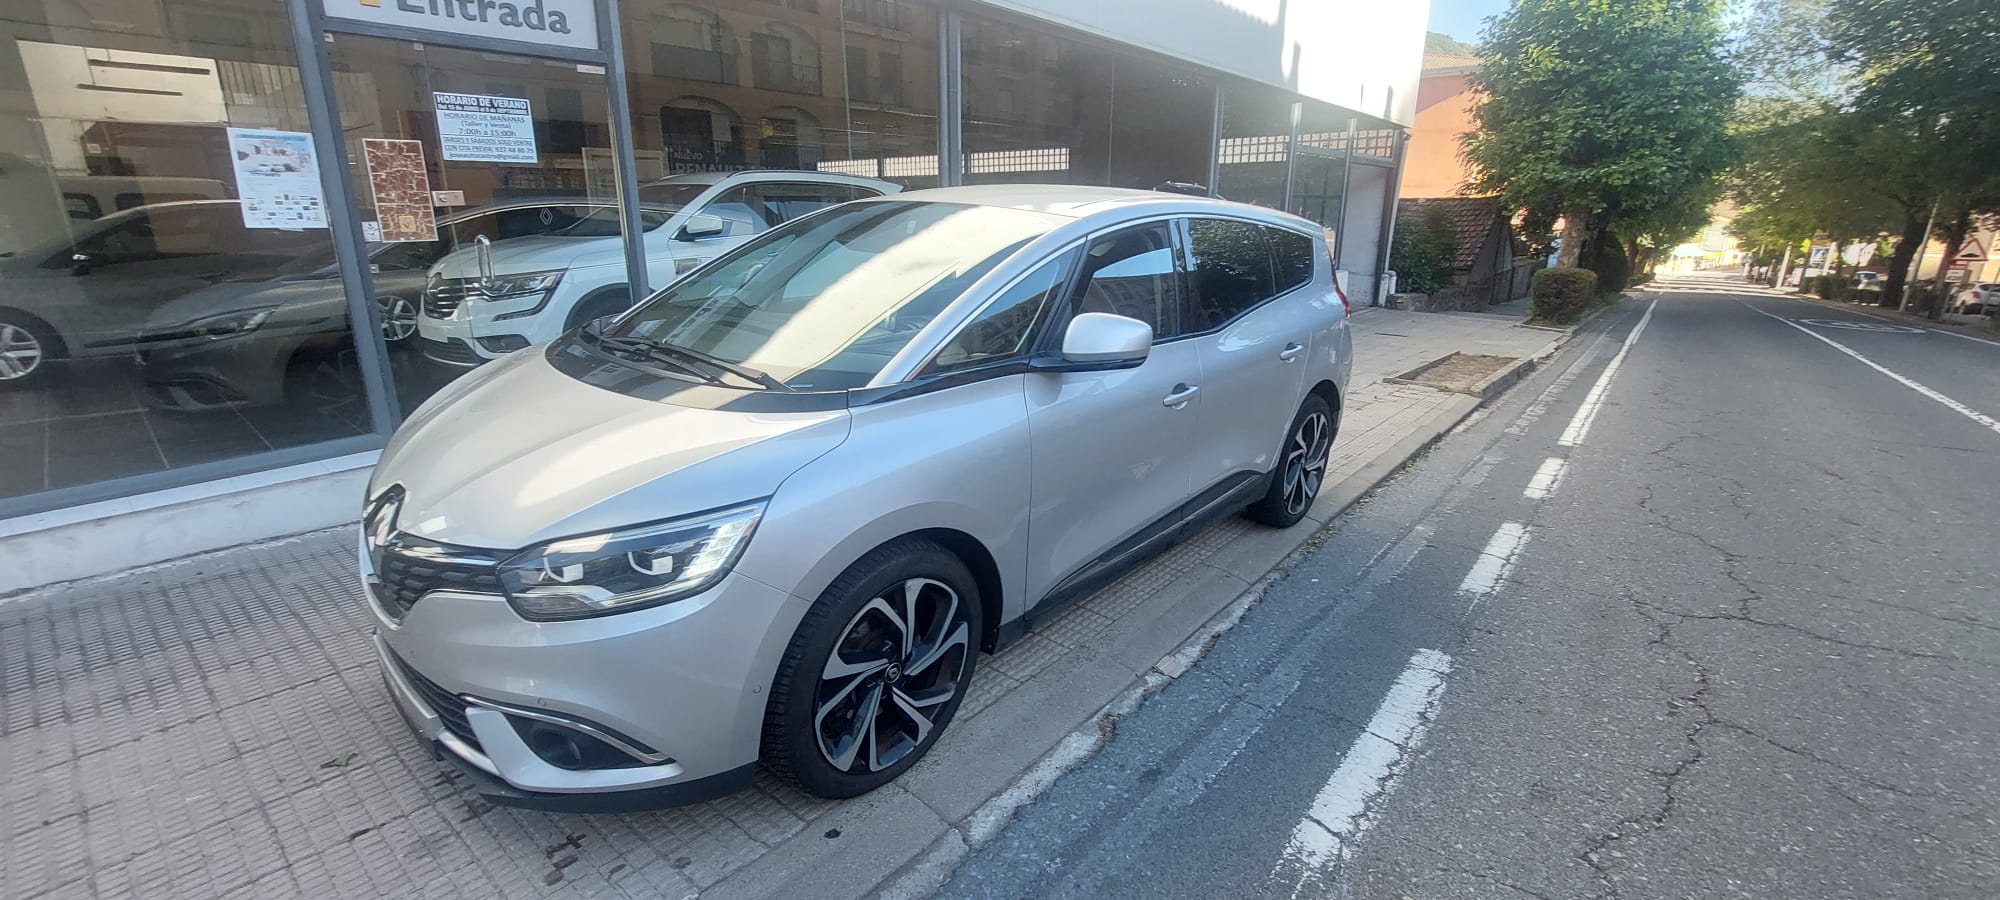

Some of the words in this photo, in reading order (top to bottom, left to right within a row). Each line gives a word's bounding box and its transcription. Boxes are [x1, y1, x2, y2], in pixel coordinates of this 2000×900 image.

[438, 95, 477, 105] HORARIO
[480, 98, 491, 106] DE
[492, 99, 526, 109] VERANO
[444, 112, 477, 120] HORARIO
[490, 115, 525, 123] MAÑANAS
[458, 127, 481, 135] 7:00h
[491, 129, 516, 137] 15:00h
